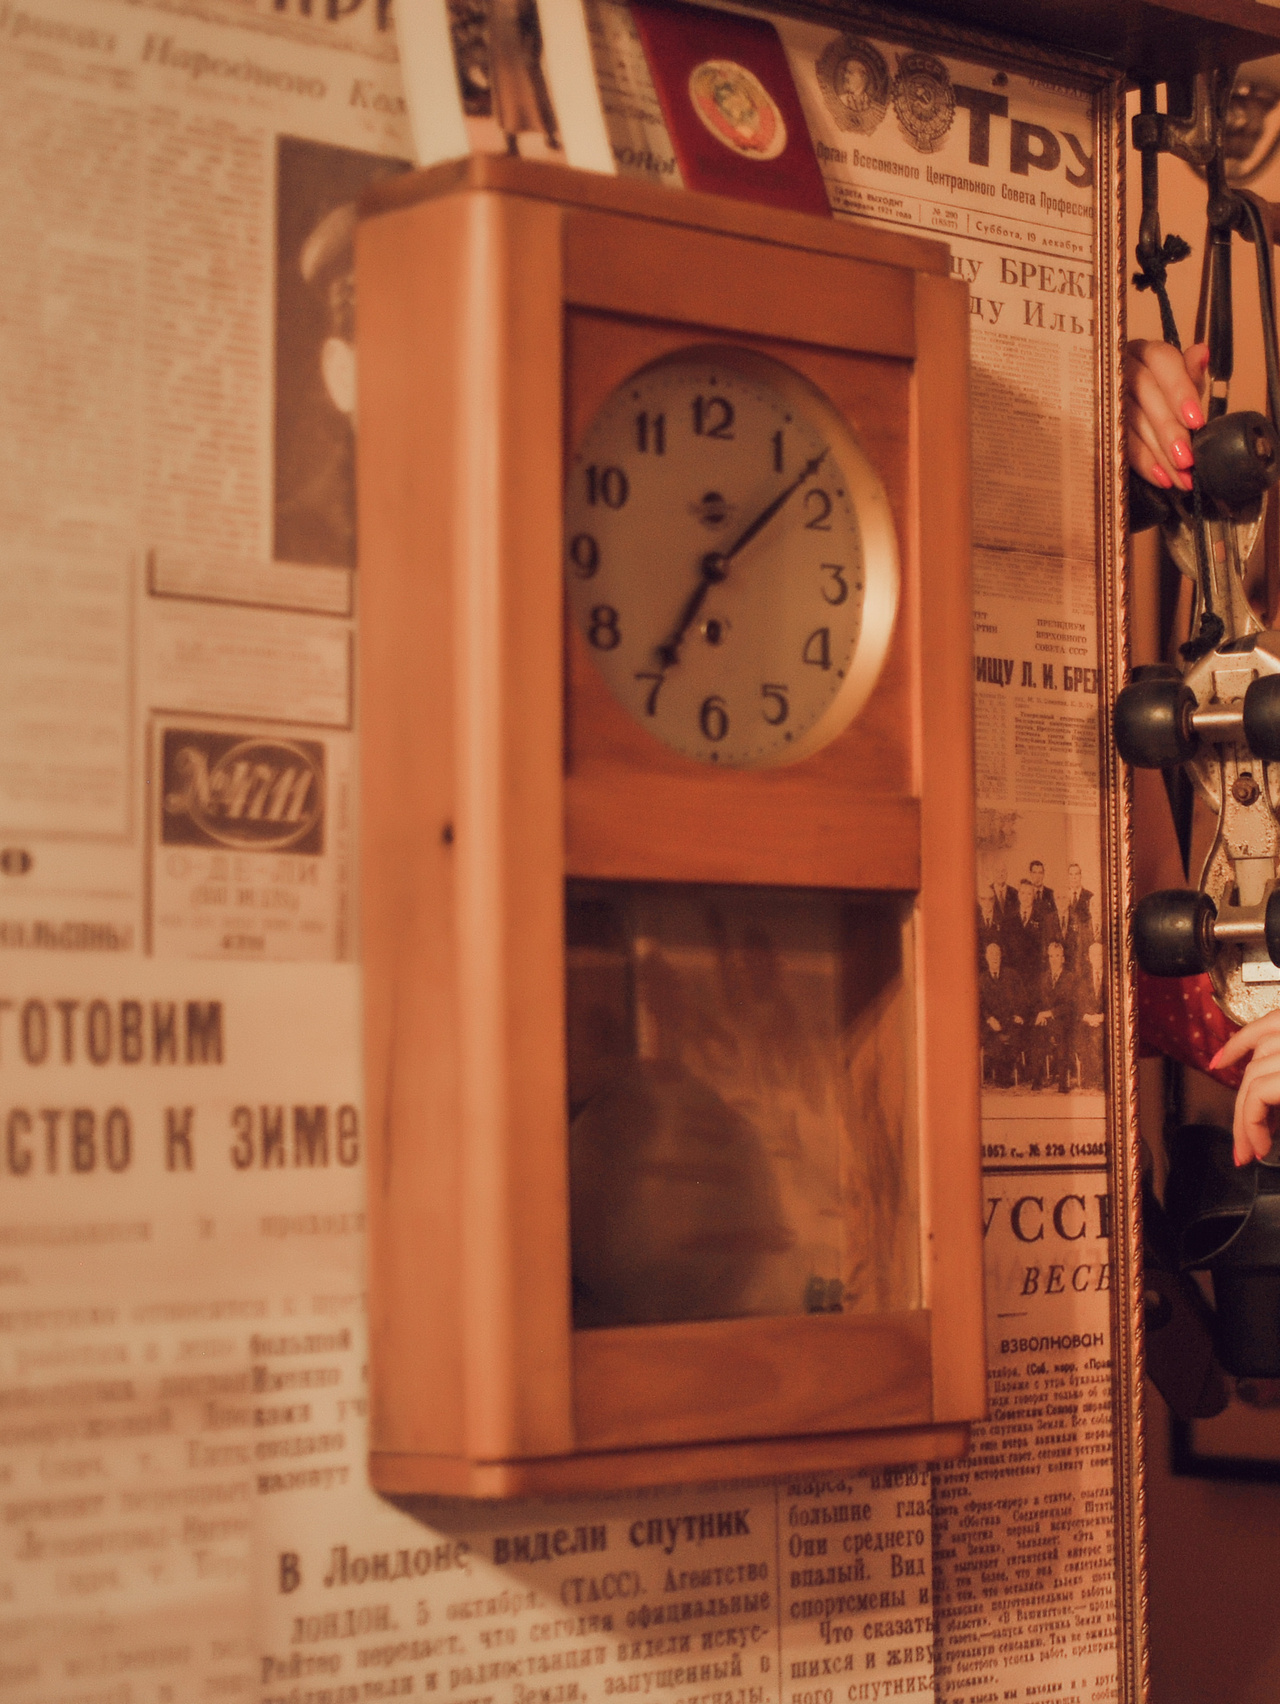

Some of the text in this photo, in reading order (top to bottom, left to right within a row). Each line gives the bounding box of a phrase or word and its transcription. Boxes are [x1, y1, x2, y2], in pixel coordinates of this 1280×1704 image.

[853, 149, 920, 180] Всесоюзного
[926, 165, 996, 197] Центрального
[1001, 183, 1036, 206] Совета
[975, 220, 1084, 253] Суббота, 19 декабря
[635, 410, 666, 457] 11
[692, 395, 735, 440] 12
[771, 430, 784, 474] 1
[585, 464, 630, 511] 10
[803, 488, 833, 531] 2
[571, 533, 599, 580] 9
[820, 563, 848, 606] 3
[587, 604, 623, 652] 8
[1035, 630, 1087, 643] ВЕРХОВНОГО
[1036, 618, 1086, 631] ПРЕЗИДИУМ
[802, 627, 832, 671] 4
[1035, 643, 1088, 656] СОВЕТА СССР
[634, 671, 665, 718] 7
[761, 683, 790, 726] 5
[701, 695, 730, 743] 6
[5, 1106, 132, 1178] СТВО
[164, 1106, 195, 1173] К
[1001, 1332, 1104, 1353] ВЗВОЛНОВАН
[789, 1504, 872, 1526] большие
[278, 1552, 302, 1594] В
[493, 1524, 607, 1566] видели
[628, 1508, 751, 1555] спутник
[789, 1528, 925, 1558] Они среднего
[664, 1561, 768, 1593] Агентство
[790, 1557, 871, 1588] впалый.
[890, 1553, 926, 1578] Вид
[626, 1591, 770, 1629] официальные
[790, 1588, 905, 1618] спортсмены
[617, 1634, 691, 1663] видели
[819, 1620, 854, 1645] Что
[604, 1651, 743, 1694] запущенный
[790, 1653, 854, 1680] шихся
[865, 1652, 876, 1670] и
